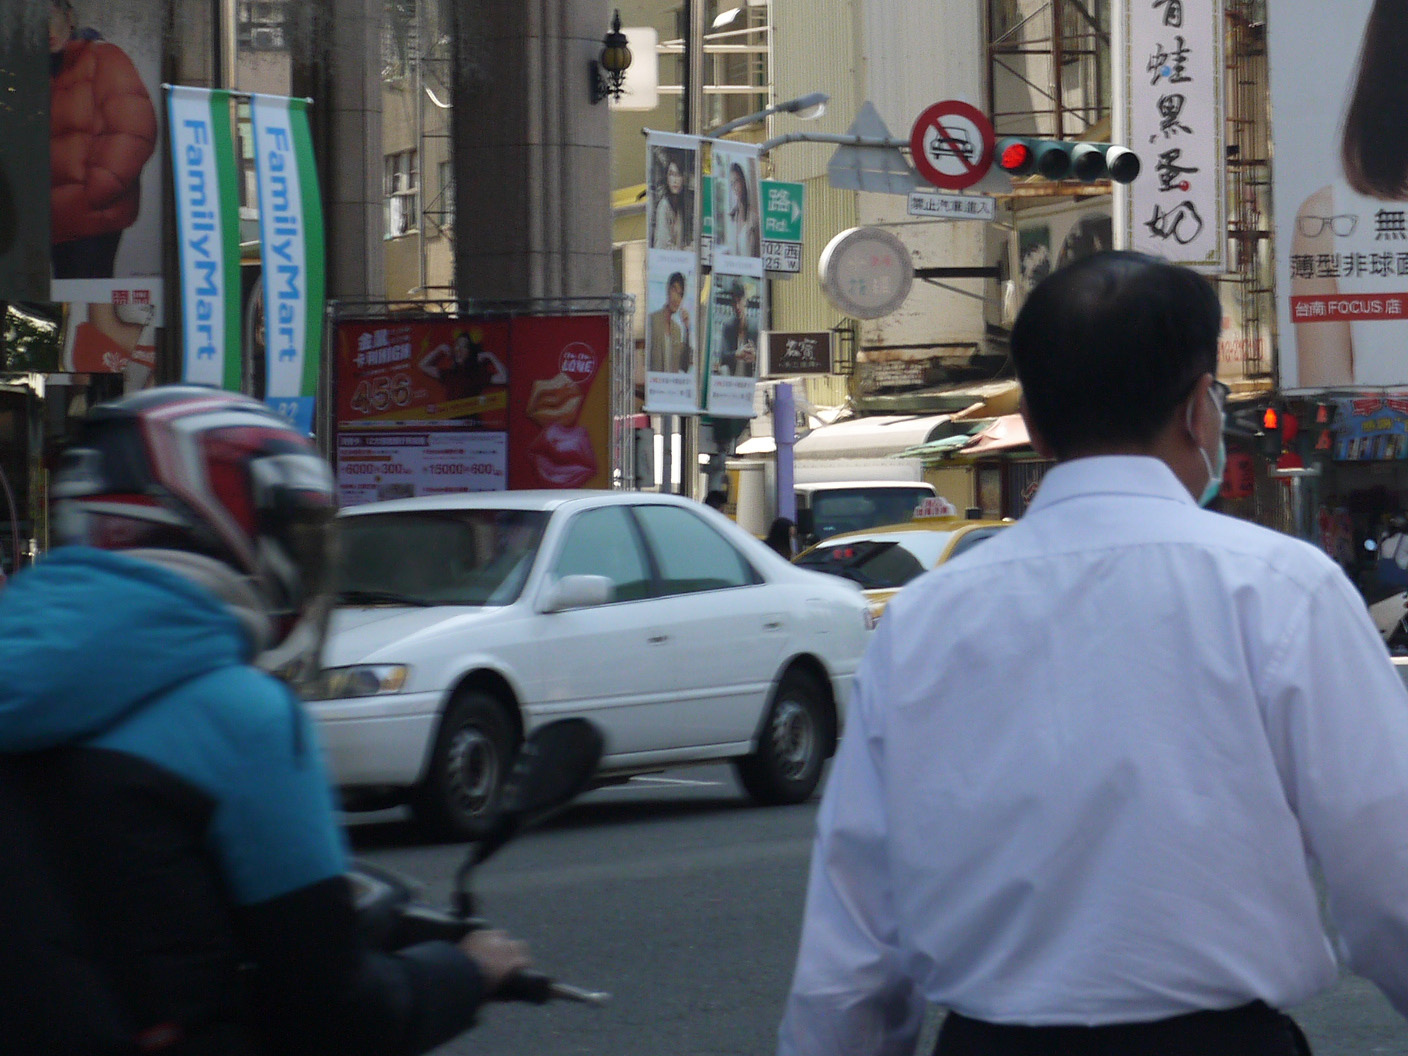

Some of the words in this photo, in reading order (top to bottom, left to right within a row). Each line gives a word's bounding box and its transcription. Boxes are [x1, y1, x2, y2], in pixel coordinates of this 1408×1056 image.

[183, 119, 218, 360] FamilyMart
[265, 127, 299, 362] FamilyMart
[911, 197, 991, 214] 禁止汽車進入
[1328, 299, 1383, 315] FOCUS
